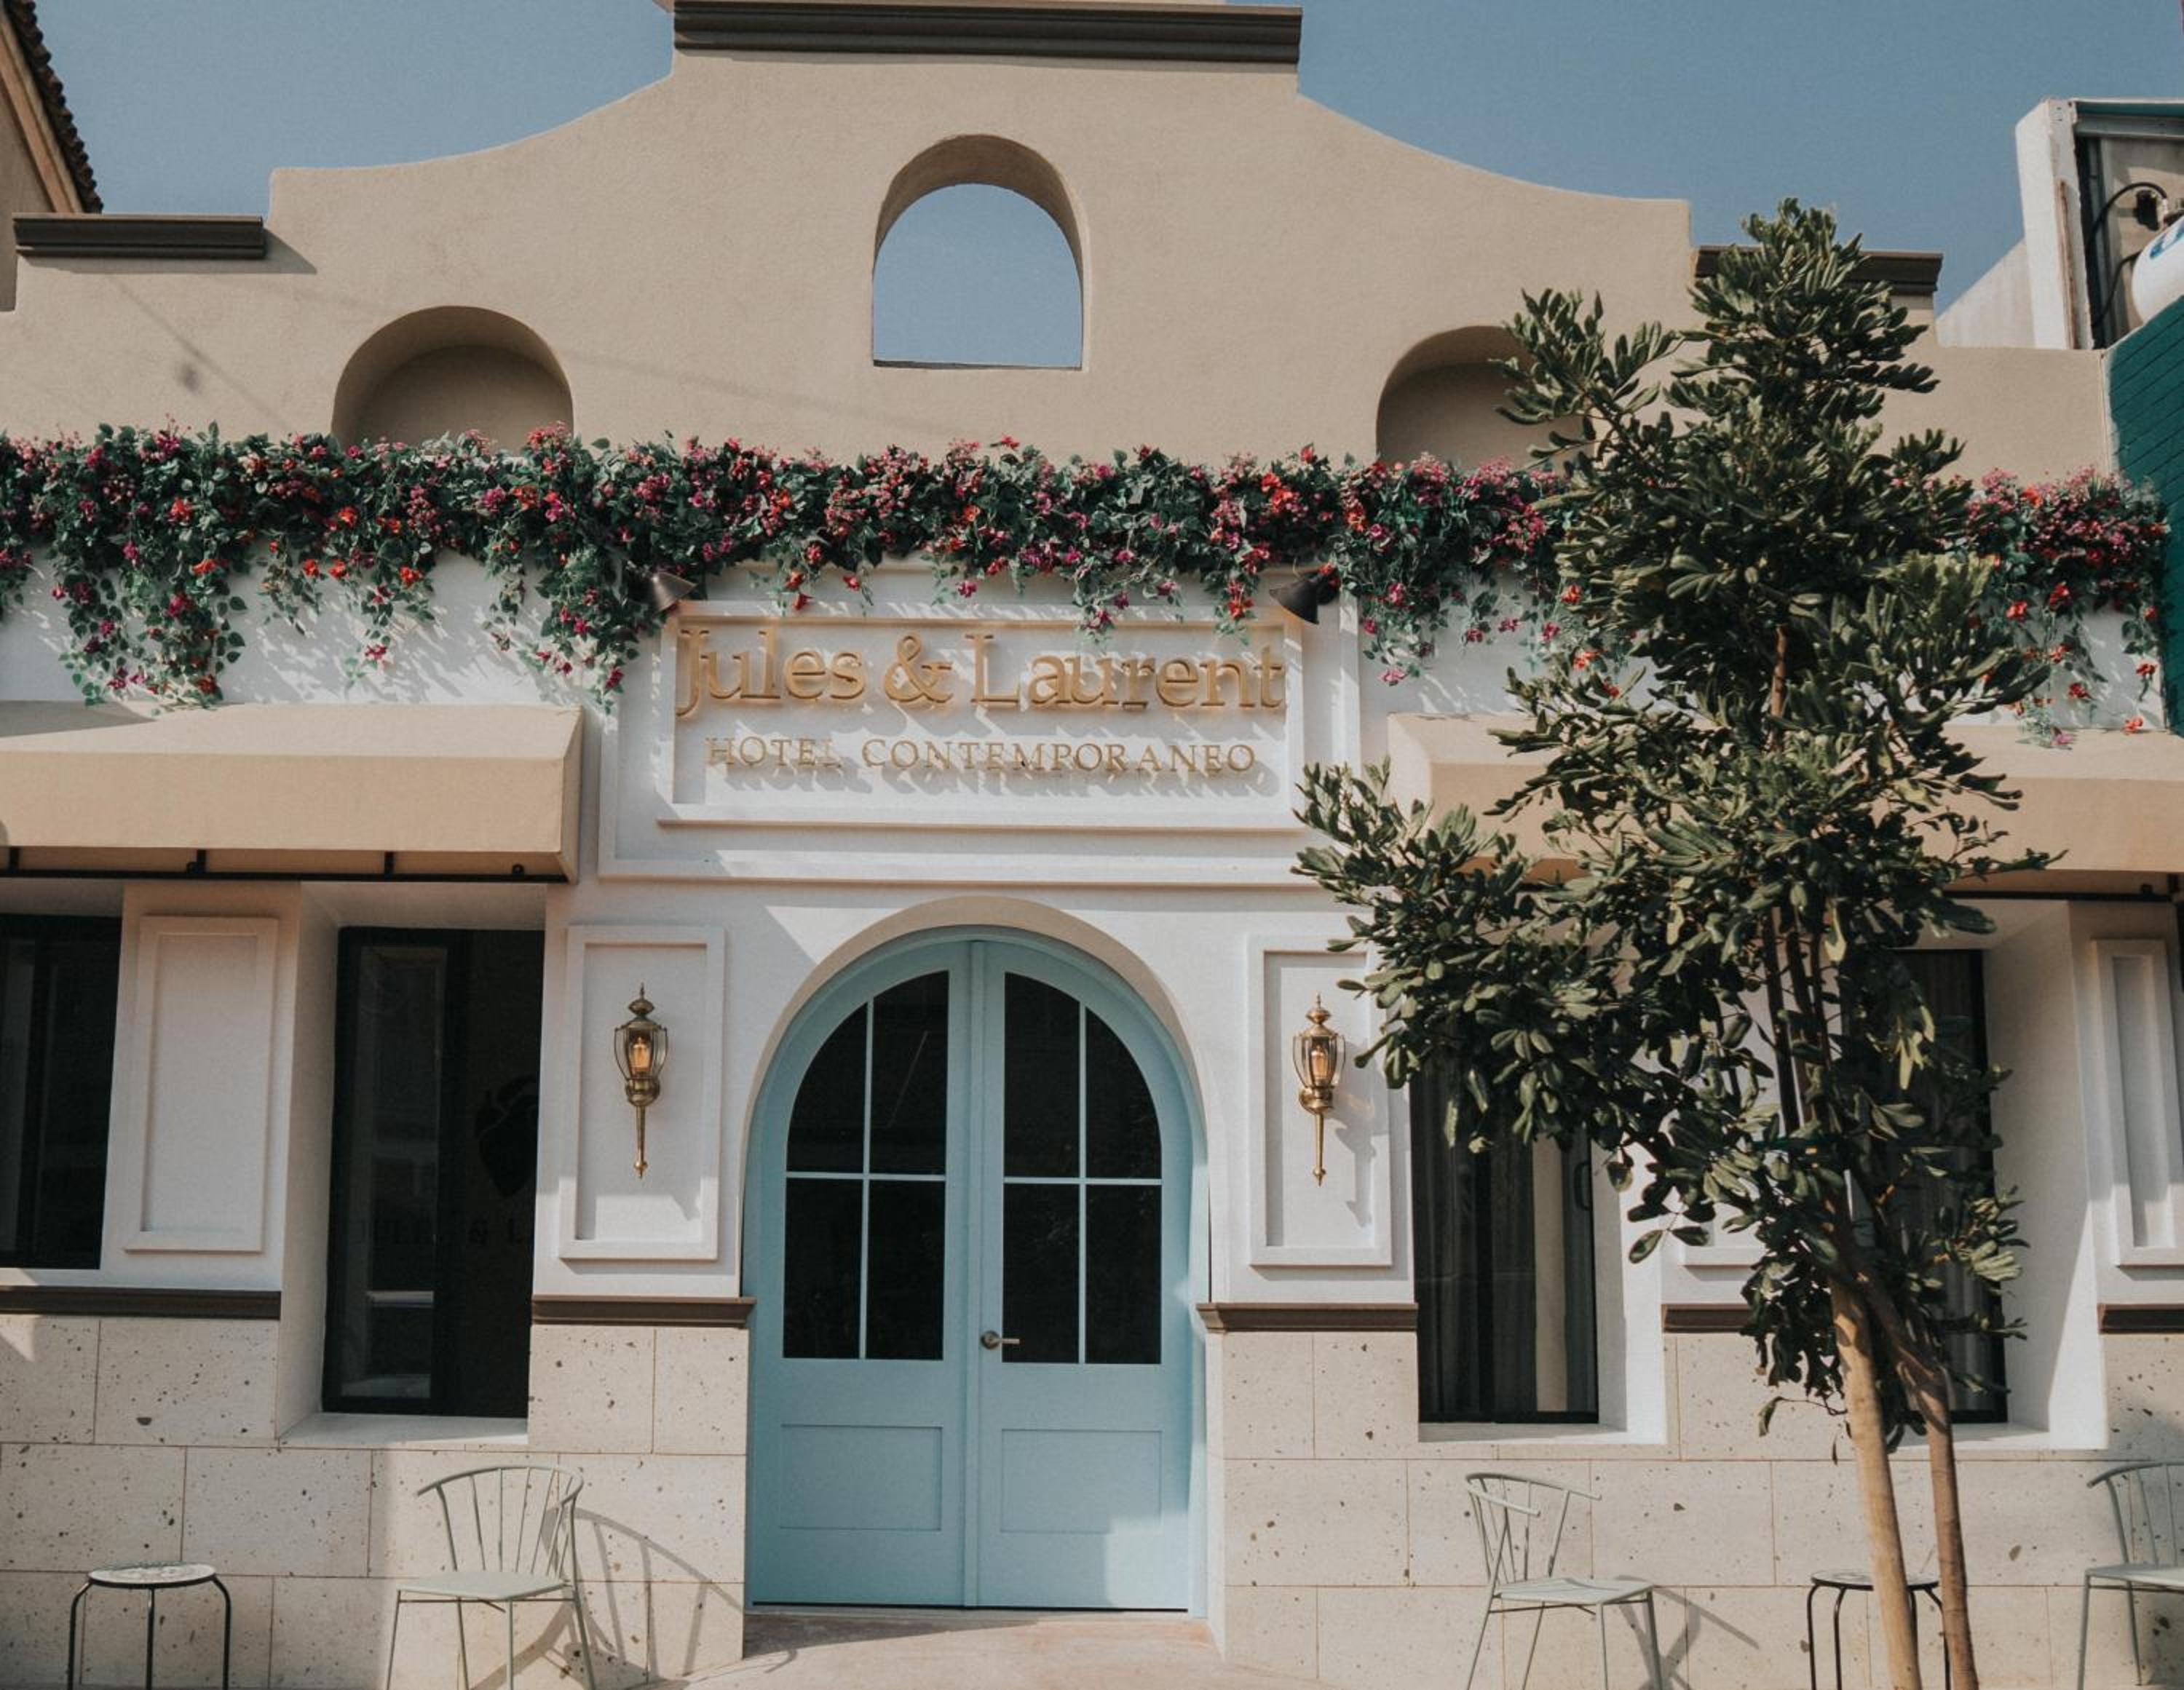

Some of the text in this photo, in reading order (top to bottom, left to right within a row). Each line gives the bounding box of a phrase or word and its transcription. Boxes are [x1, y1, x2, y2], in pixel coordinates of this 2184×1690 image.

[675, 627, 1284, 716] Jules & Laurent
[705, 735, 1255, 772] HOTEL CONTEMPORANEO
